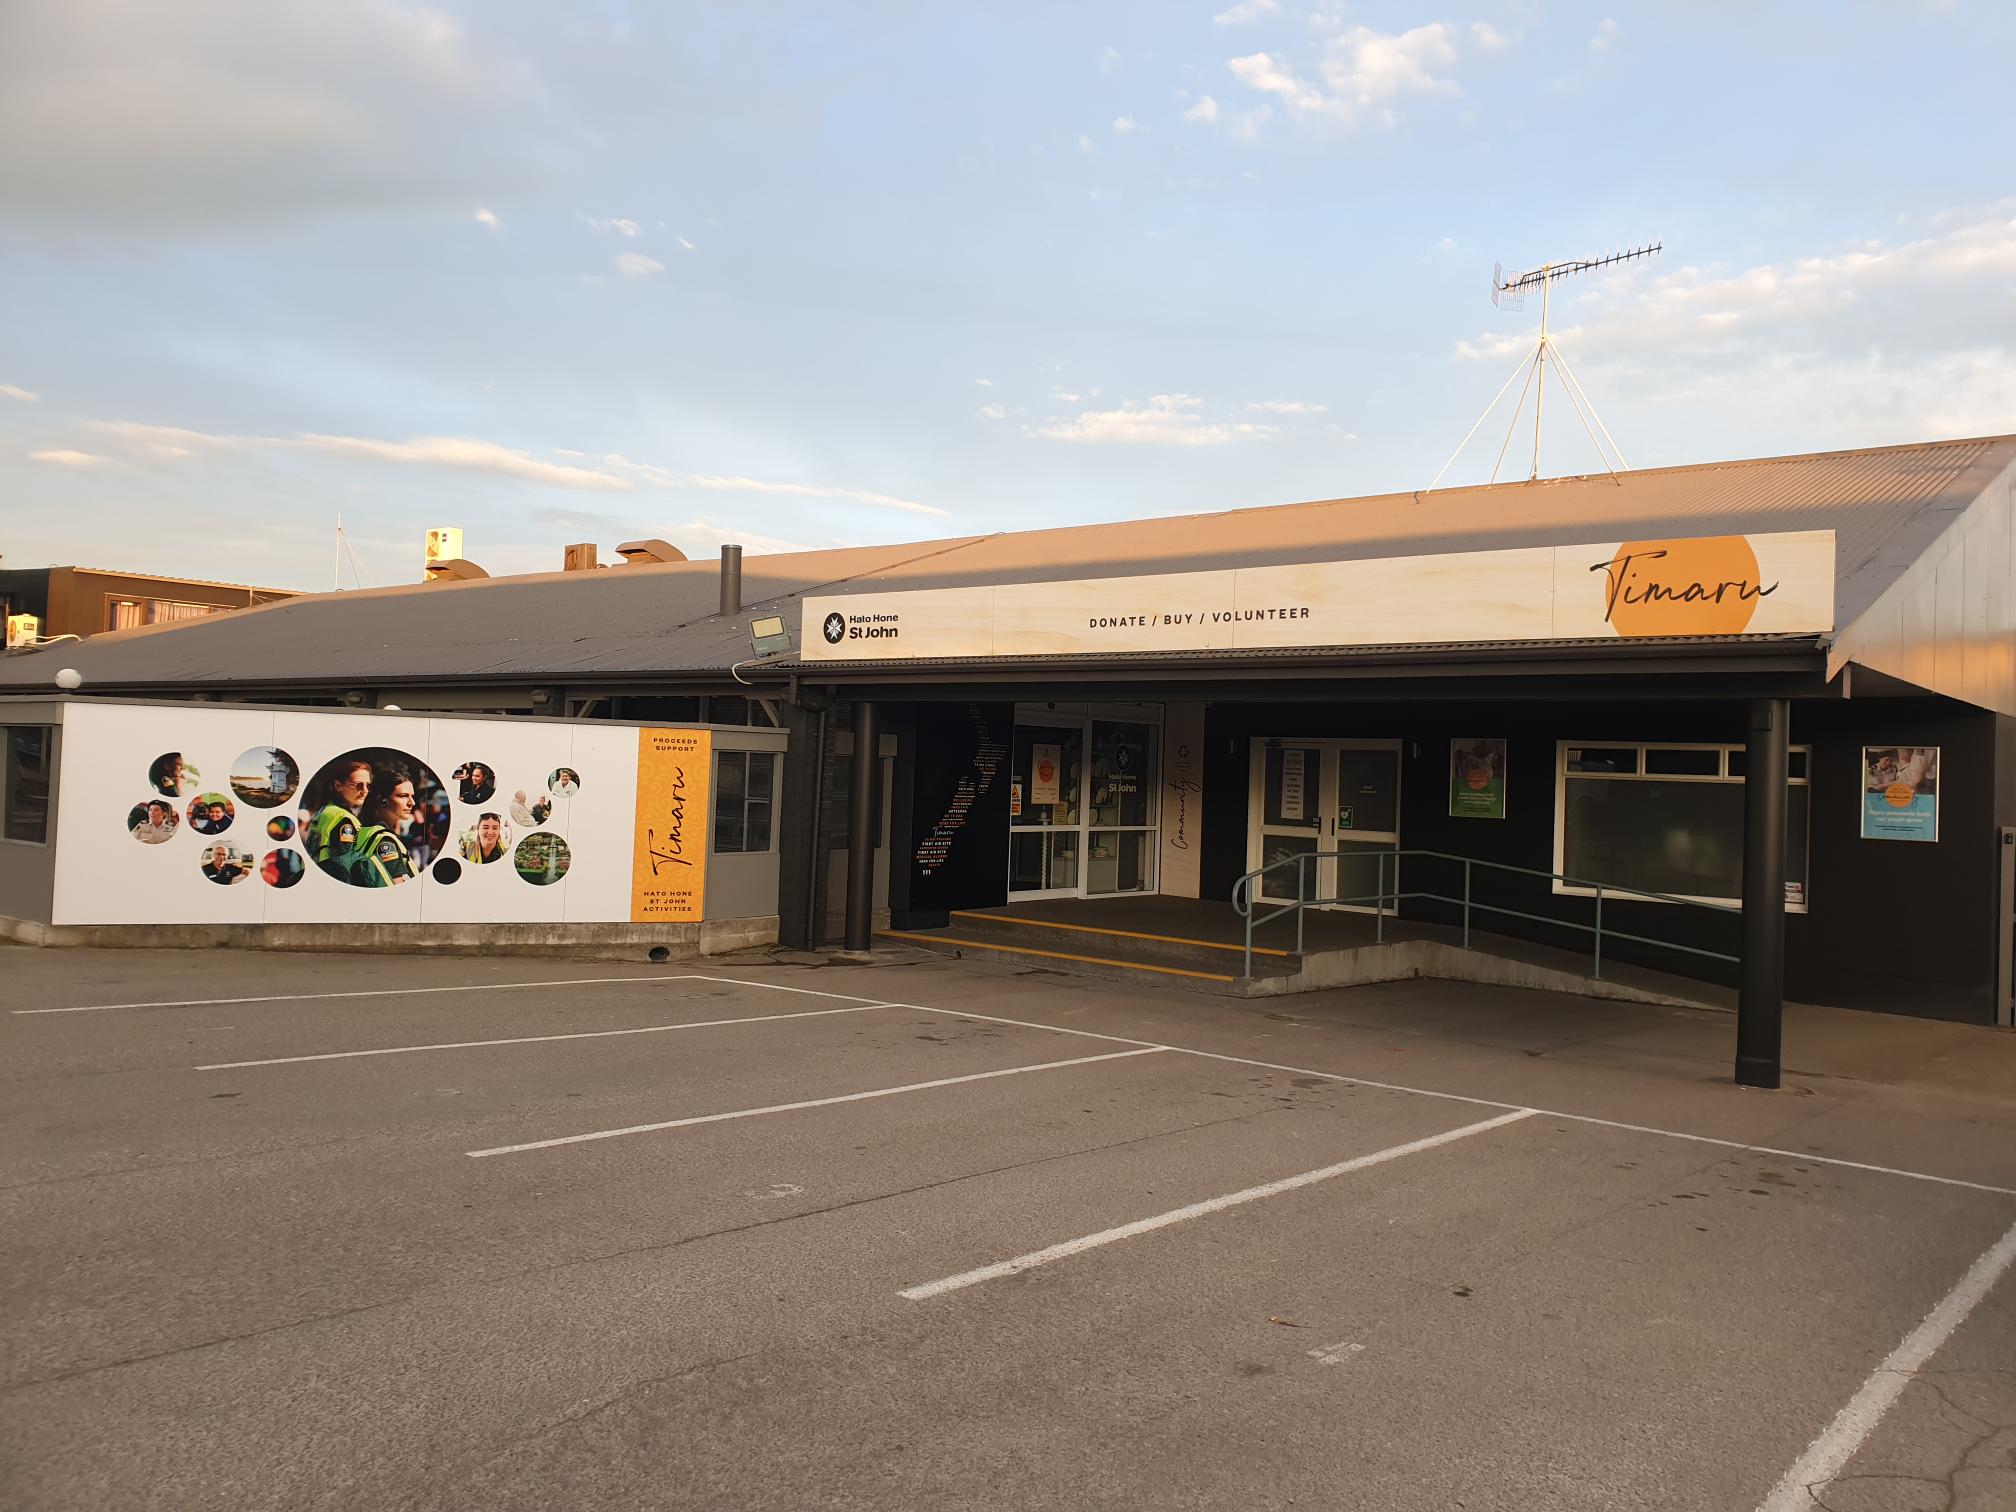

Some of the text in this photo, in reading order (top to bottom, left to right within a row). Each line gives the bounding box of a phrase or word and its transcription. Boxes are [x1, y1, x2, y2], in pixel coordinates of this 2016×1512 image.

[1590, 550, 1779, 622] Timaru
[849, 613, 899, 623] Hato Hone
[1090, 616, 1145, 628] DONATE
[1164, 614, 1193, 625] BUY
[1212, 607, 1310, 622] VOLUNTEER
[849, 626, 899, 639] St John
[653, 737, 698, 745] PROCEEDS
[1108, 783, 1137, 793] St John
[648, 766, 693, 876] Timaru
[1168, 776, 1201, 850] Community
